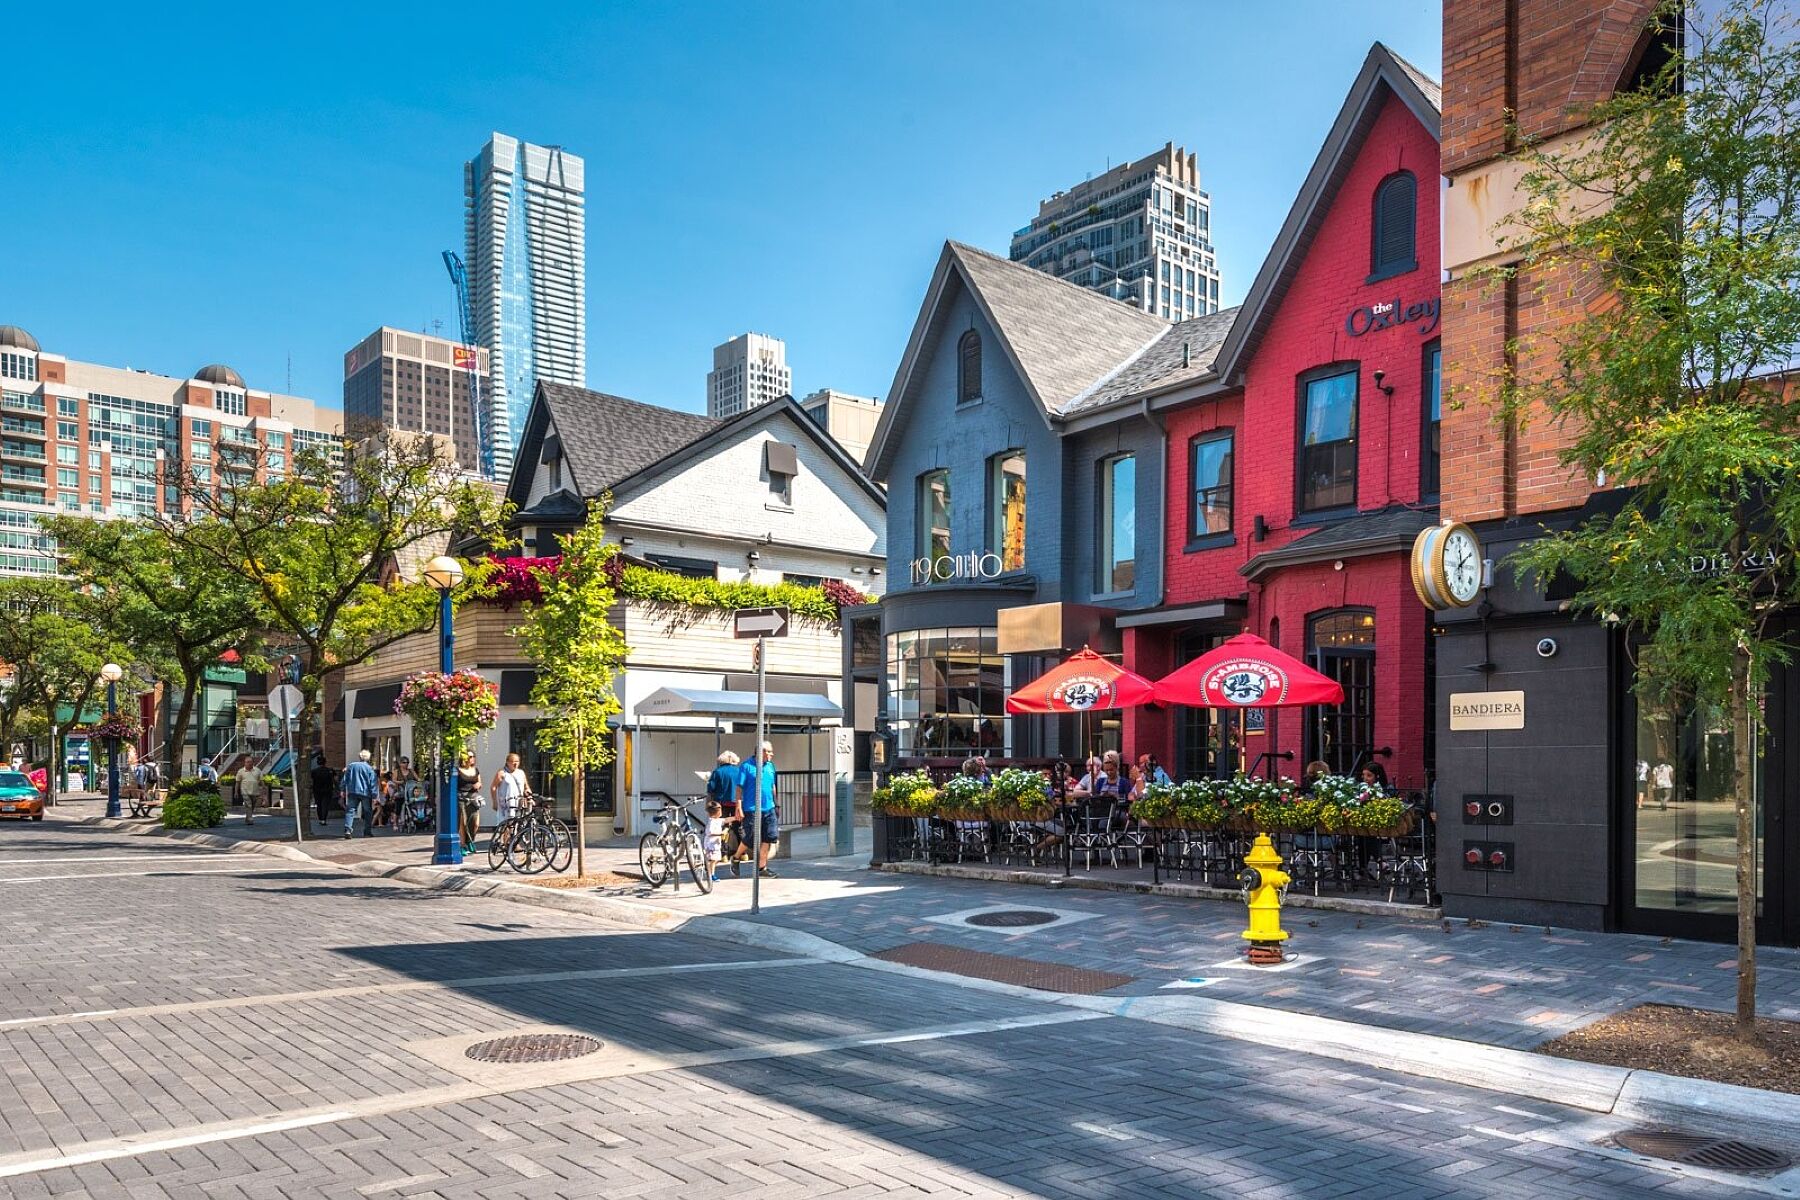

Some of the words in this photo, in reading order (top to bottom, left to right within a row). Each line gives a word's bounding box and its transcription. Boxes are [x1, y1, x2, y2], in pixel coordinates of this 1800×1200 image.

[1346, 296, 1441, 337] Oxley
[1373, 303, 1393, 315] the
[909, 557, 932, 585] 119
[1452, 703, 1522, 715] BANDIERA
